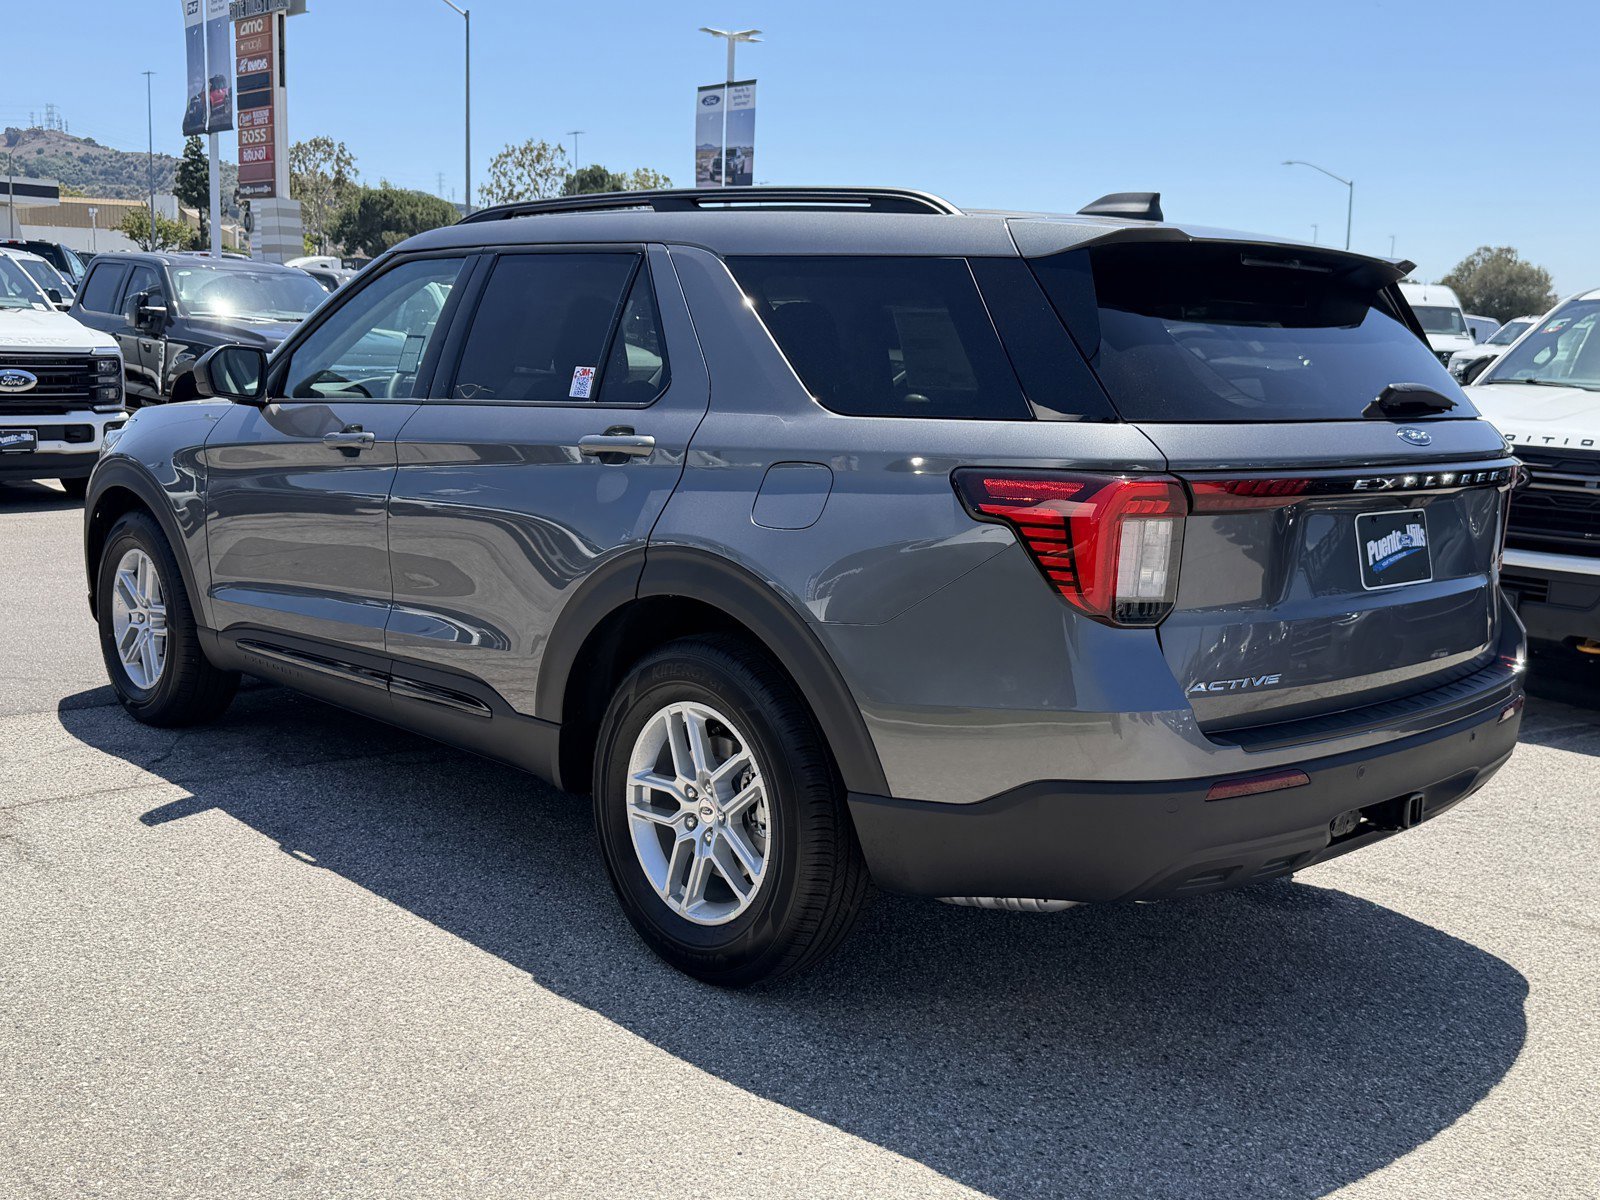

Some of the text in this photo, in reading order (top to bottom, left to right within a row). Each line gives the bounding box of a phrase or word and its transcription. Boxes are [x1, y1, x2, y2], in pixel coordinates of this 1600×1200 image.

[242, 128, 266, 143] ROSS
[1, 375, 25, 386] Ford
[1367, 530, 1402, 566] Puente
[1406, 524, 1426, 547] Hills
[1189, 674, 1282, 692] ACTIVE
